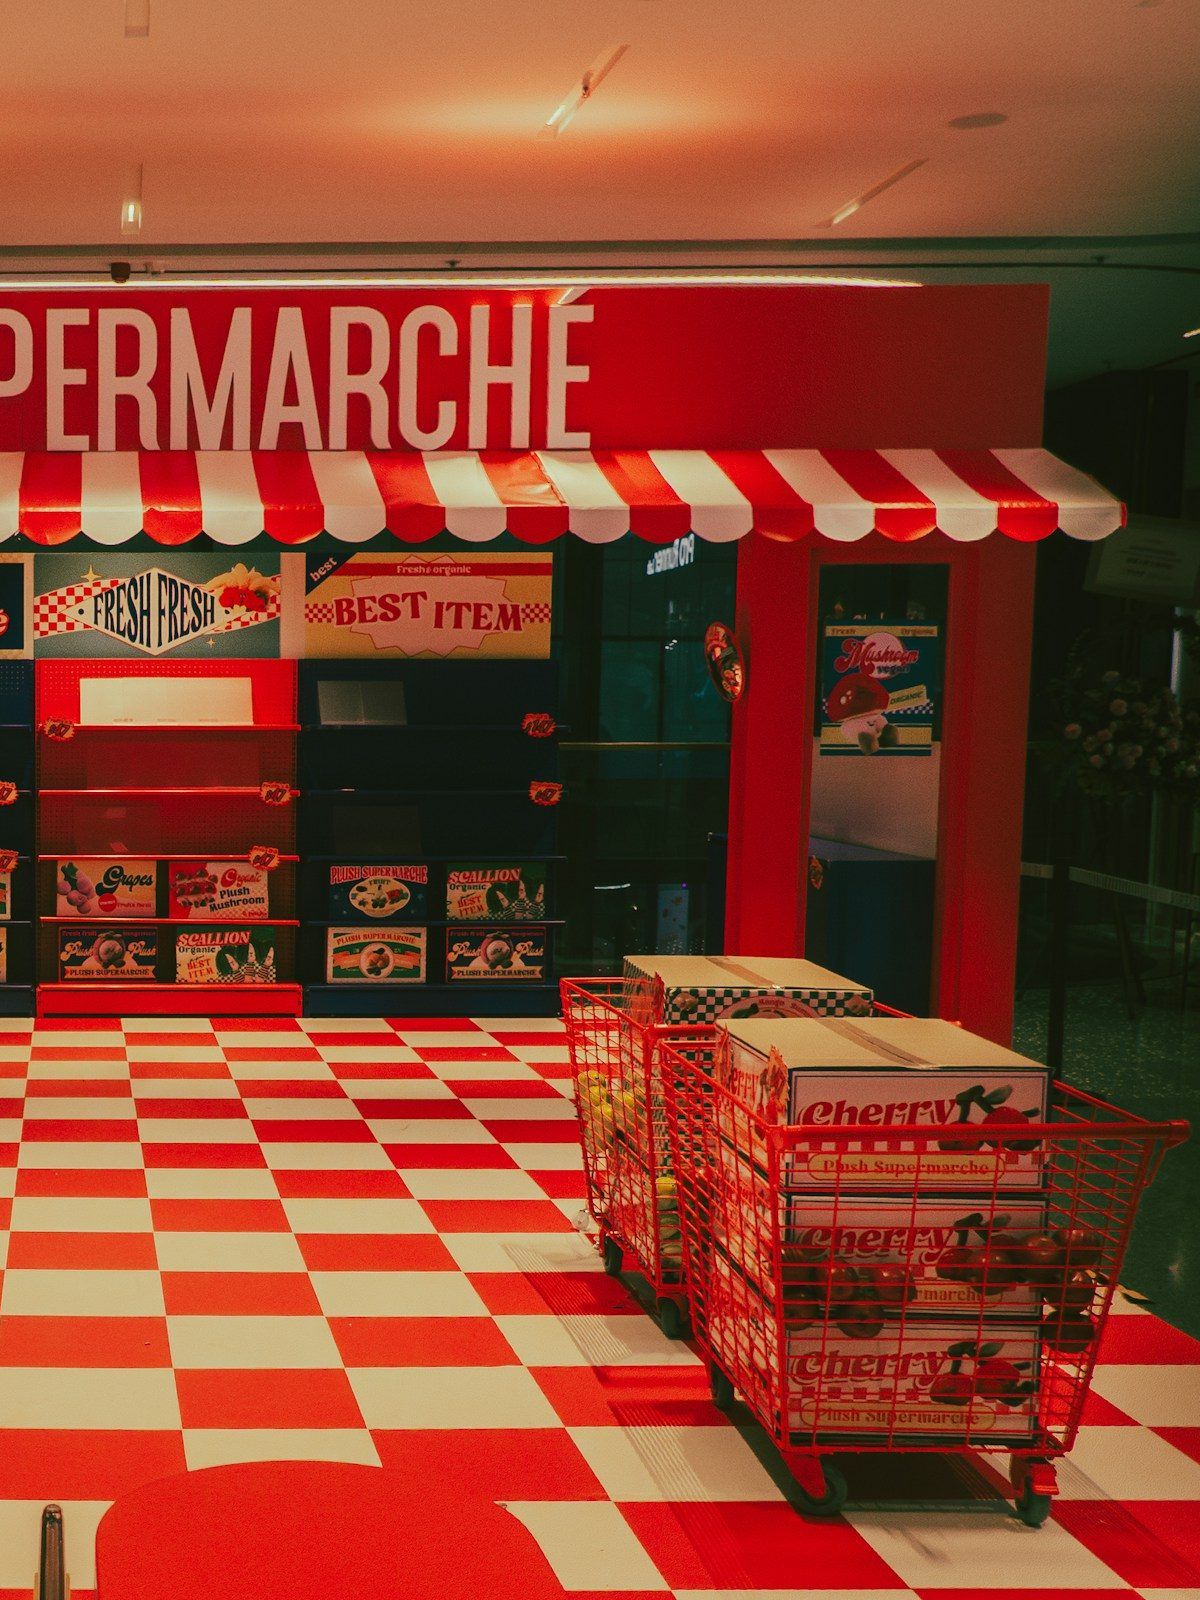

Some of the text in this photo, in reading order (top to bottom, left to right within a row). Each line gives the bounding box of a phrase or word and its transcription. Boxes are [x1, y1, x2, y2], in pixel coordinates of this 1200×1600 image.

[309, 557, 338, 582] best
[94, 572, 215, 648] FRESH FRESH
[334, 591, 523, 631] BEST ITEM
[95, 865, 153, 896] Grapes
[330, 866, 361, 885] PLUSH
[448, 868, 521, 884] SCALLION
[219, 888, 250, 899] Plush
[449, 883, 487, 893] Organic
[209, 897, 265, 912] Mushroom
[457, 895, 482, 908] BEST
[459, 905, 484, 917] ITEM
[176, 931, 251, 947] SCALLION
[178, 946, 216, 955] Organic
[187, 958, 211, 970] BEST
[188, 968, 214, 979] ITEM
[798, 1098, 960, 1126] Cherry
[823, 1159, 868, 1174] Plush
[791, 1350, 950, 1390] Cherry
